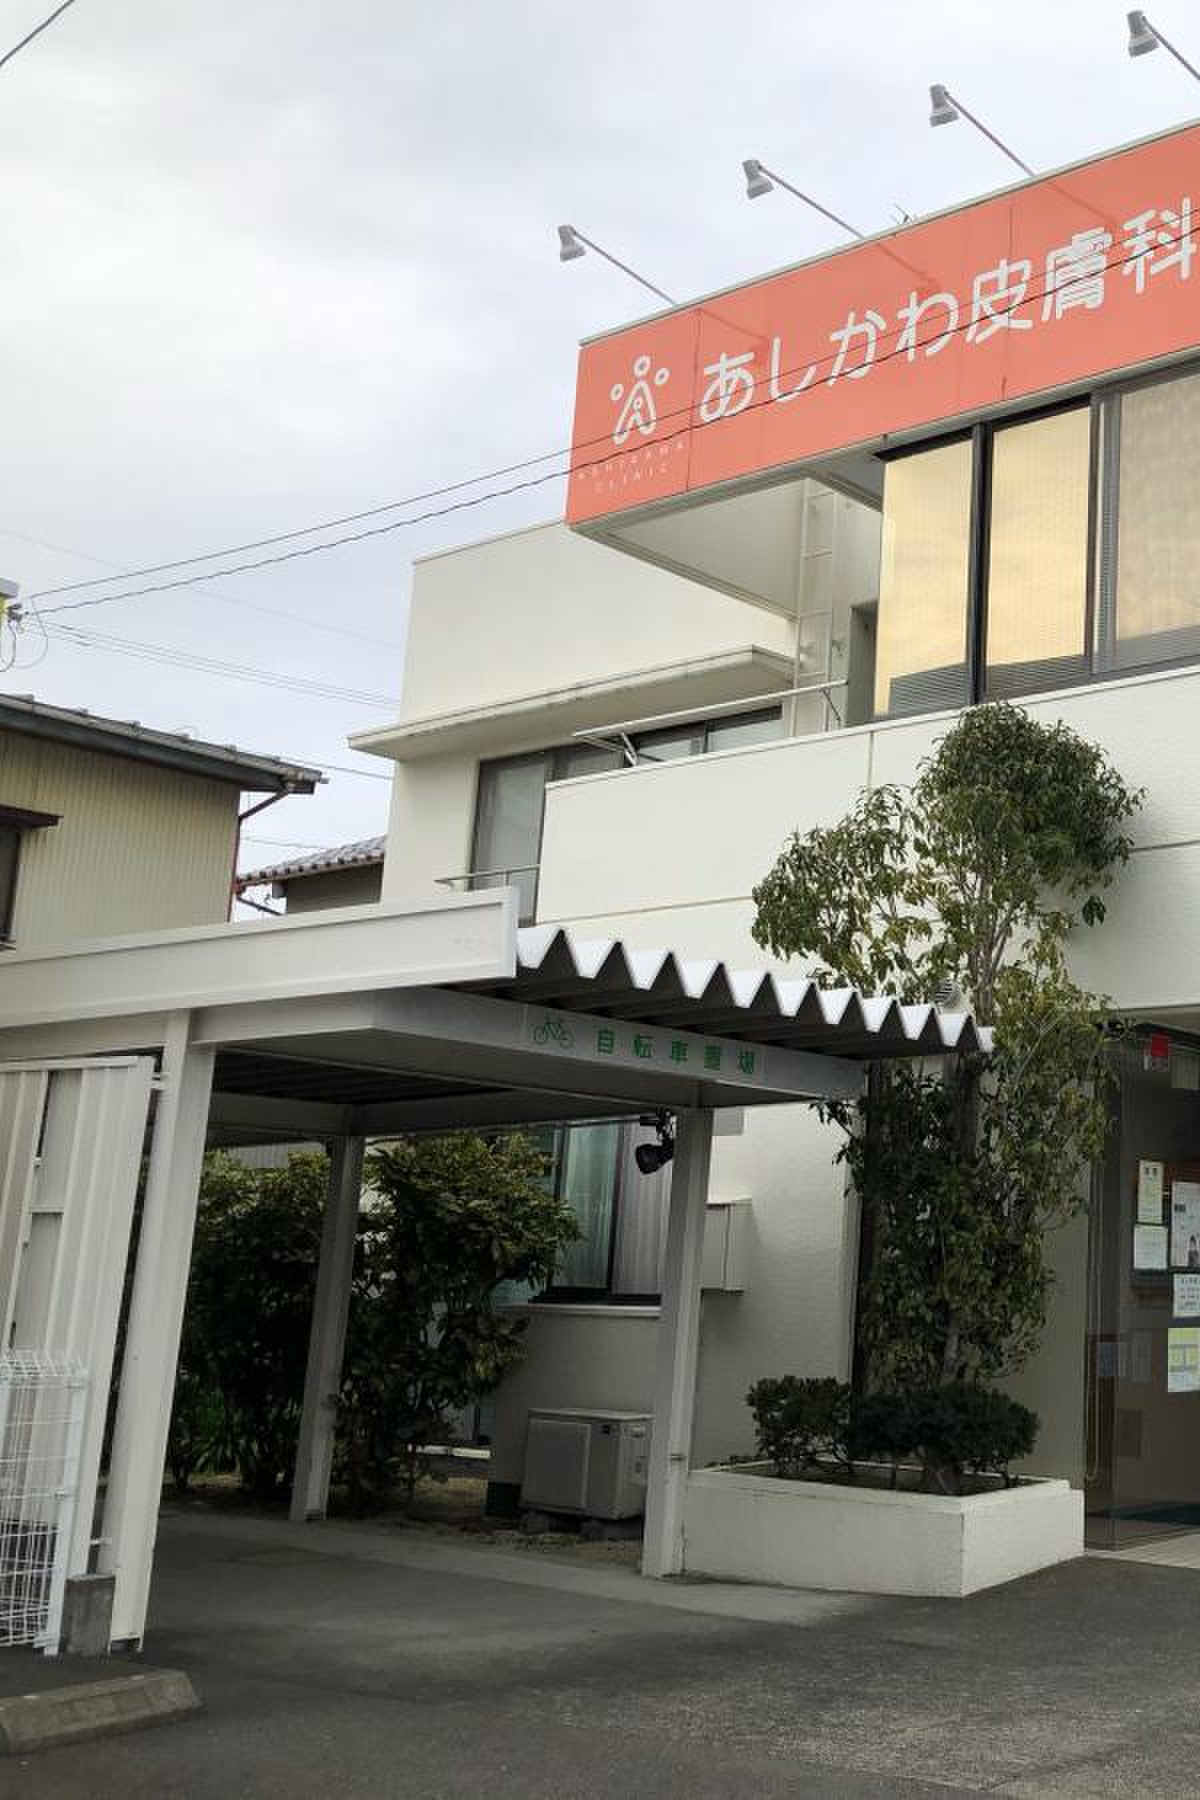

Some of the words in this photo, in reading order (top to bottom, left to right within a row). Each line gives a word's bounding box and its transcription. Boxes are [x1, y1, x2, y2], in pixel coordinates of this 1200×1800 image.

[698, 195, 1199, 423] あしかわ皮膚科
[596, 1027, 756, 1075] 自転車置場
